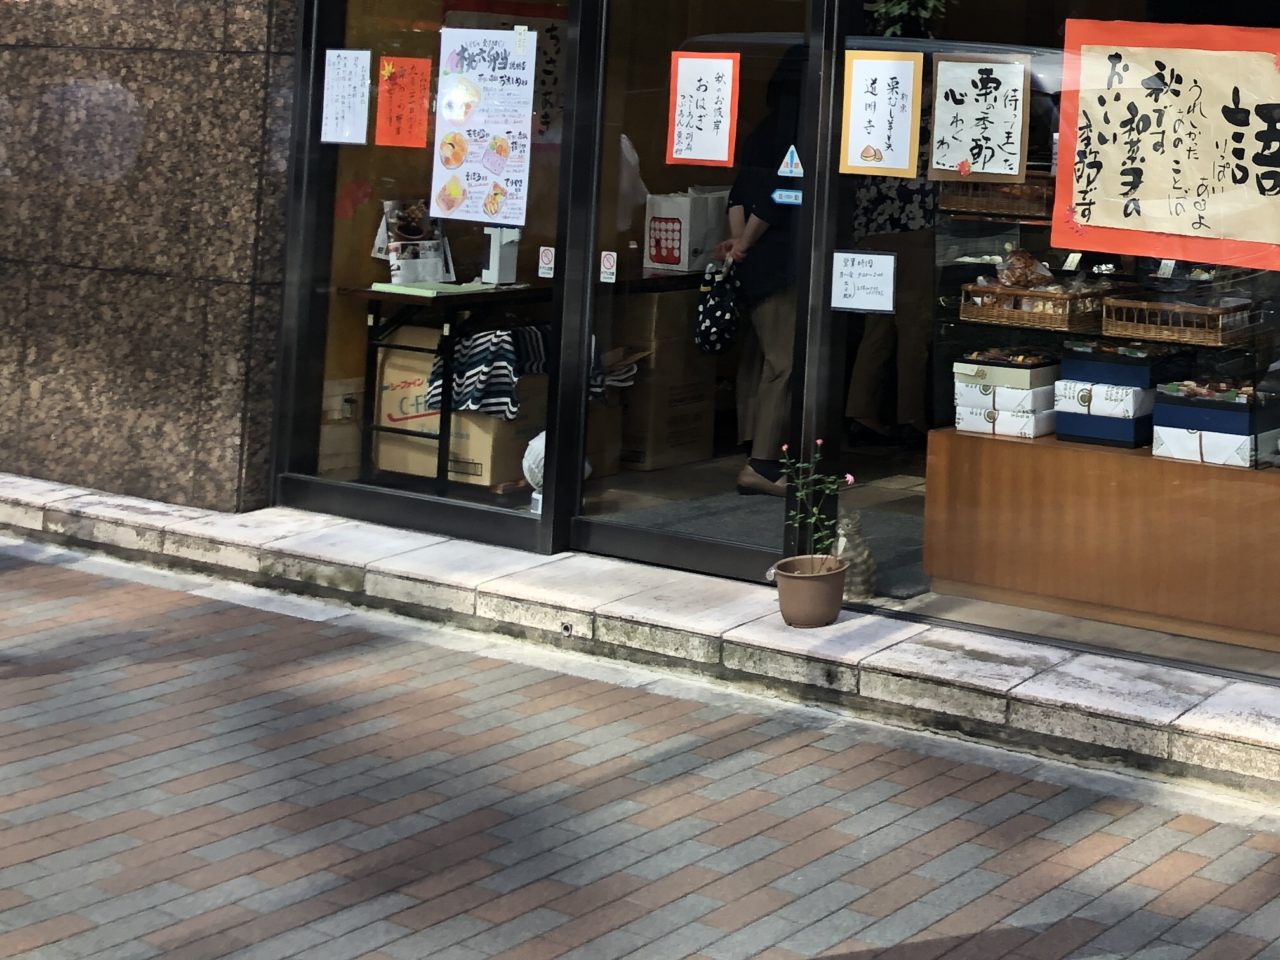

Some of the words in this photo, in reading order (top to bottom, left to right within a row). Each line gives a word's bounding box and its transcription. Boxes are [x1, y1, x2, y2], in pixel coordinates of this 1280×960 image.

[695, 75, 708, 132] おはぎ
[863, 76, 879, 135] 道明寺
[969, 67, 1002, 171] 栗の季節
[1096, 51, 1130, 147] おいしい
[1141, 59, 1184, 156] 秋です
[1073, 109, 1104, 223] 季節です
[1119, 100, 1153, 219] 和菓子の
